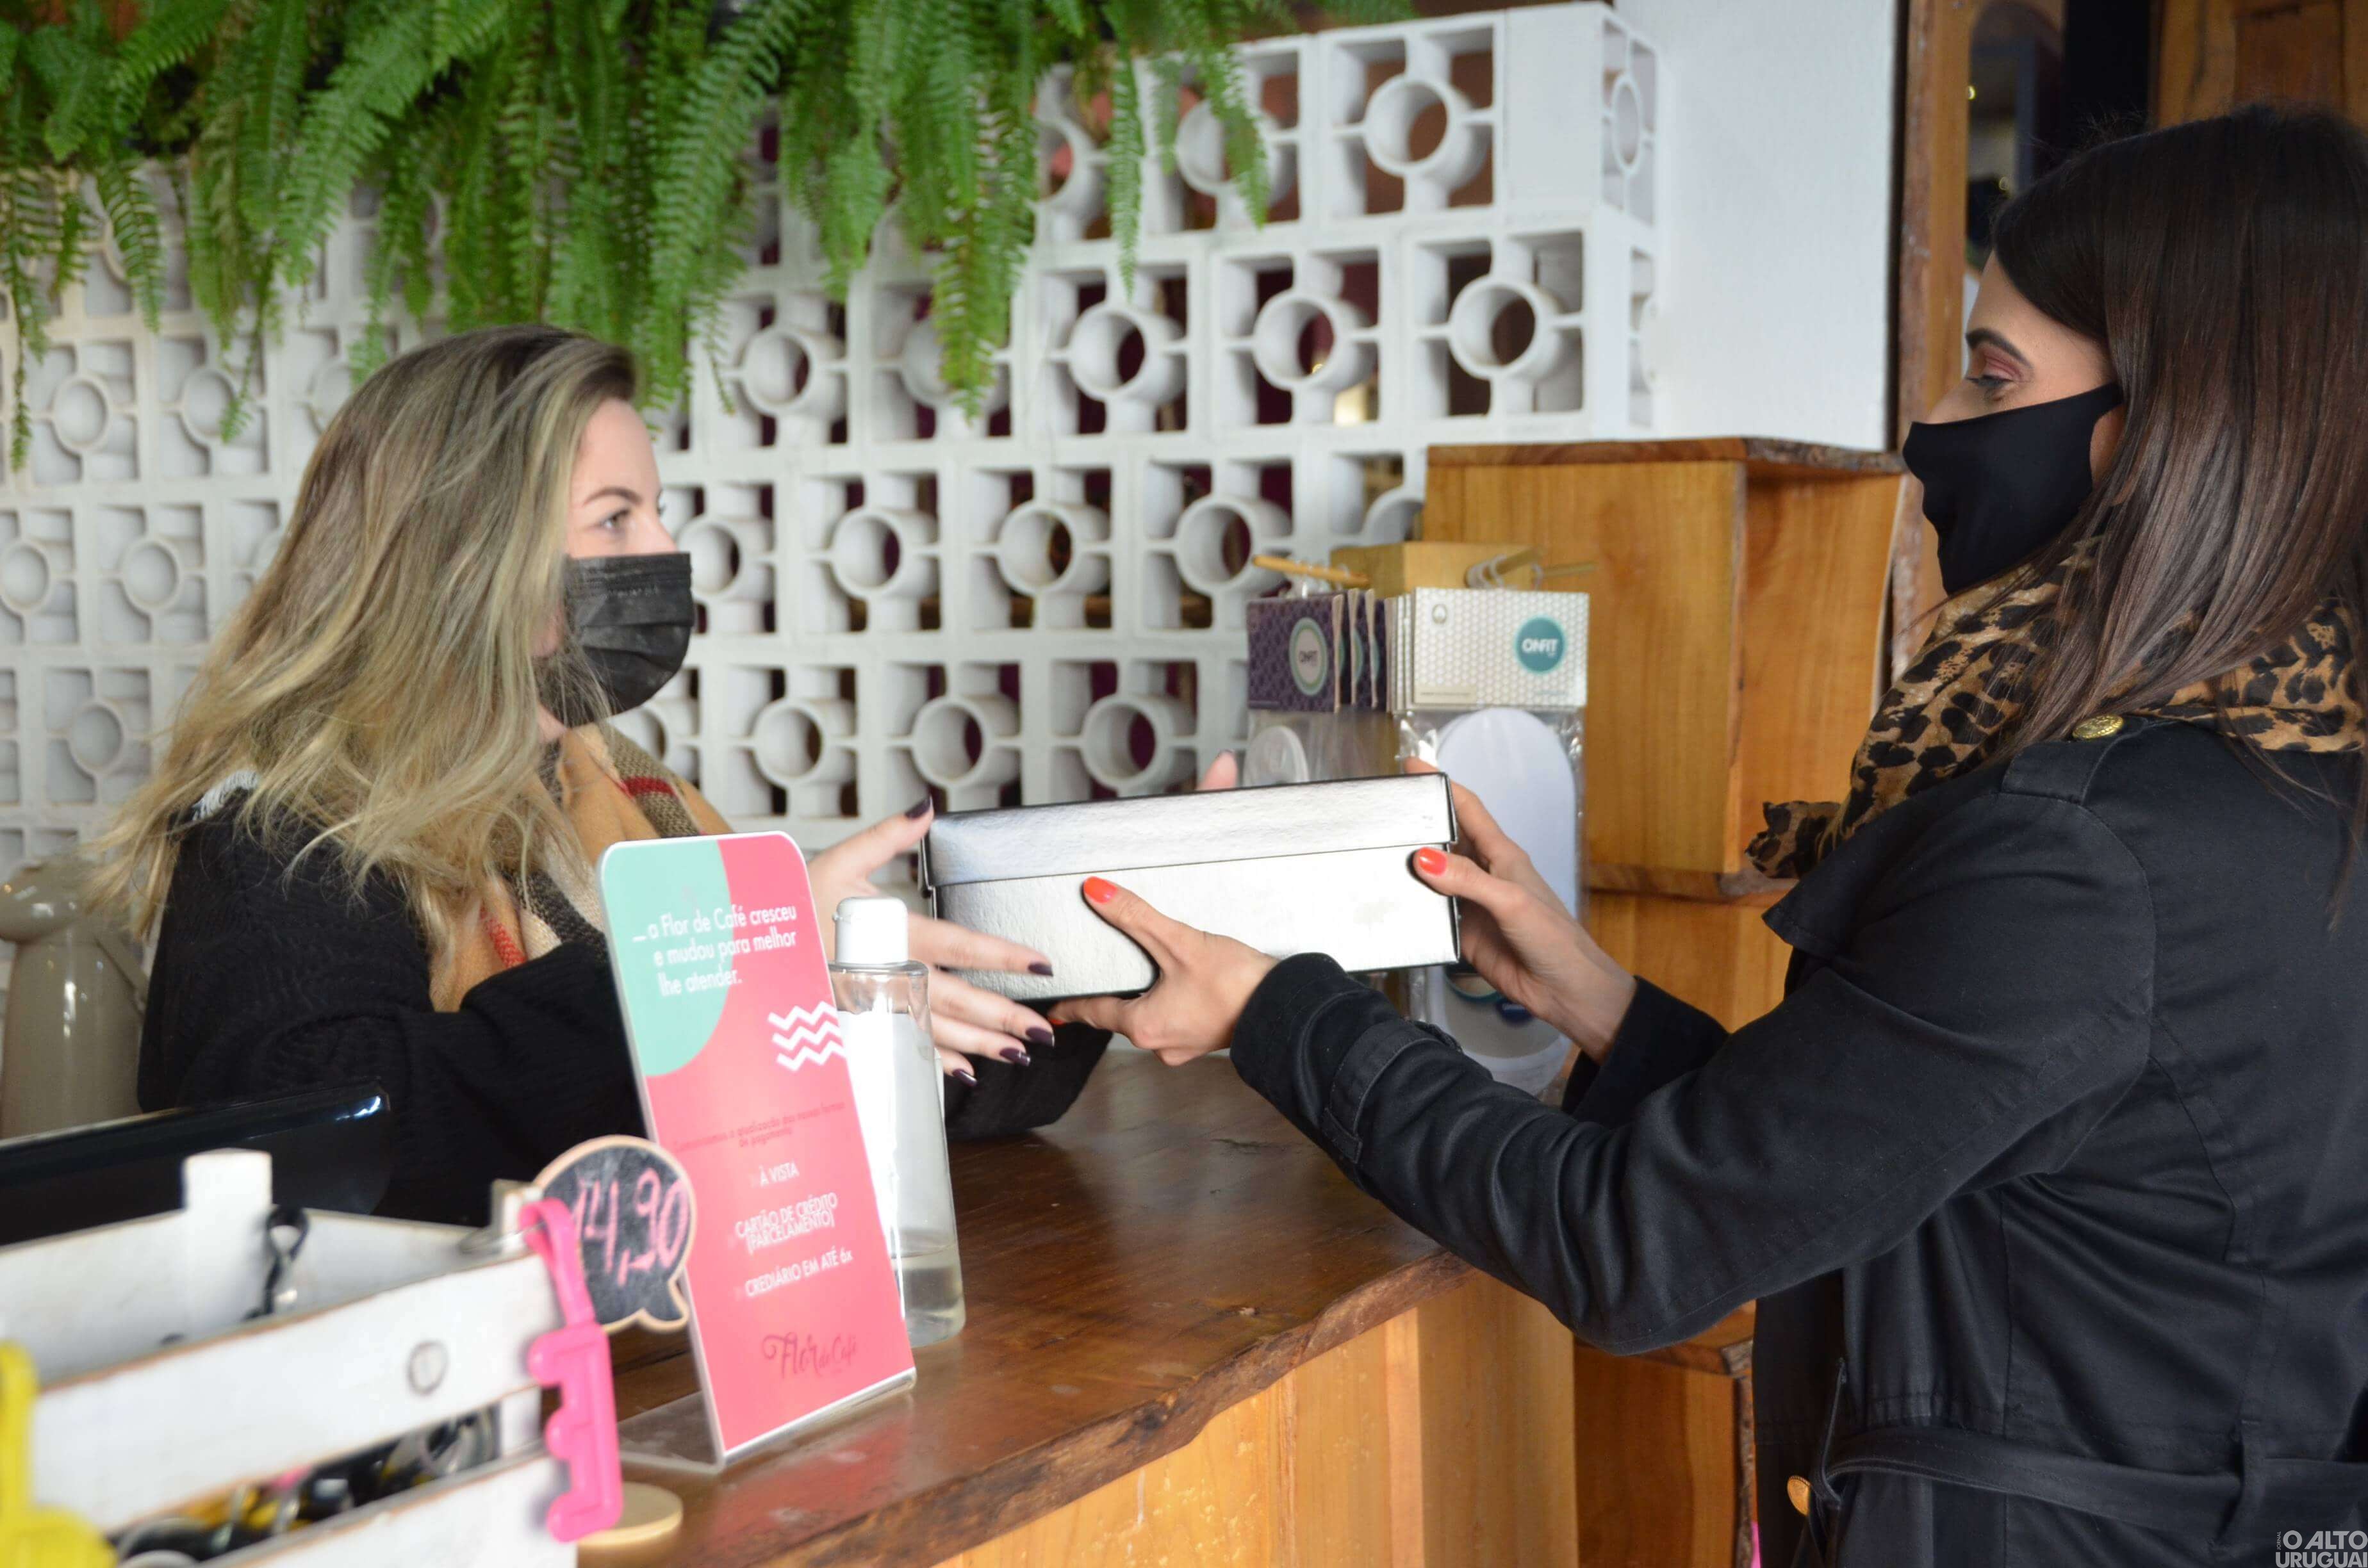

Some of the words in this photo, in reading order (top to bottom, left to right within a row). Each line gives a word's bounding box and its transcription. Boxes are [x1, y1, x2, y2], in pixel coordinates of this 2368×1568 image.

[660, 912, 689, 936] Flor
[693, 909, 711, 933] de
[714, 904, 747, 930] Café
[750, 905, 796, 926] cresceu
[654, 950, 664, 967] e
[666, 937, 715, 964] mudou
[718, 938, 751, 963] para
[753, 926, 797, 952] melhor
[657, 971, 682, 997] lhe
[685, 963, 743, 993] atender.
[759, 1165, 769, 1185] À
[769, 1161, 800, 1182] VISTA
[736, 1209, 779, 1238] CARTÃO
[780, 1205, 794, 1224] DE
[796, 1191, 838, 1218] CRÉDITO
[744, 1263, 802, 1297] CREDIÁRIO
[802, 1257, 819, 1277] EM
[821, 1245, 839, 1270] ATÉ
[839, 1246, 853, 1264] 6x
